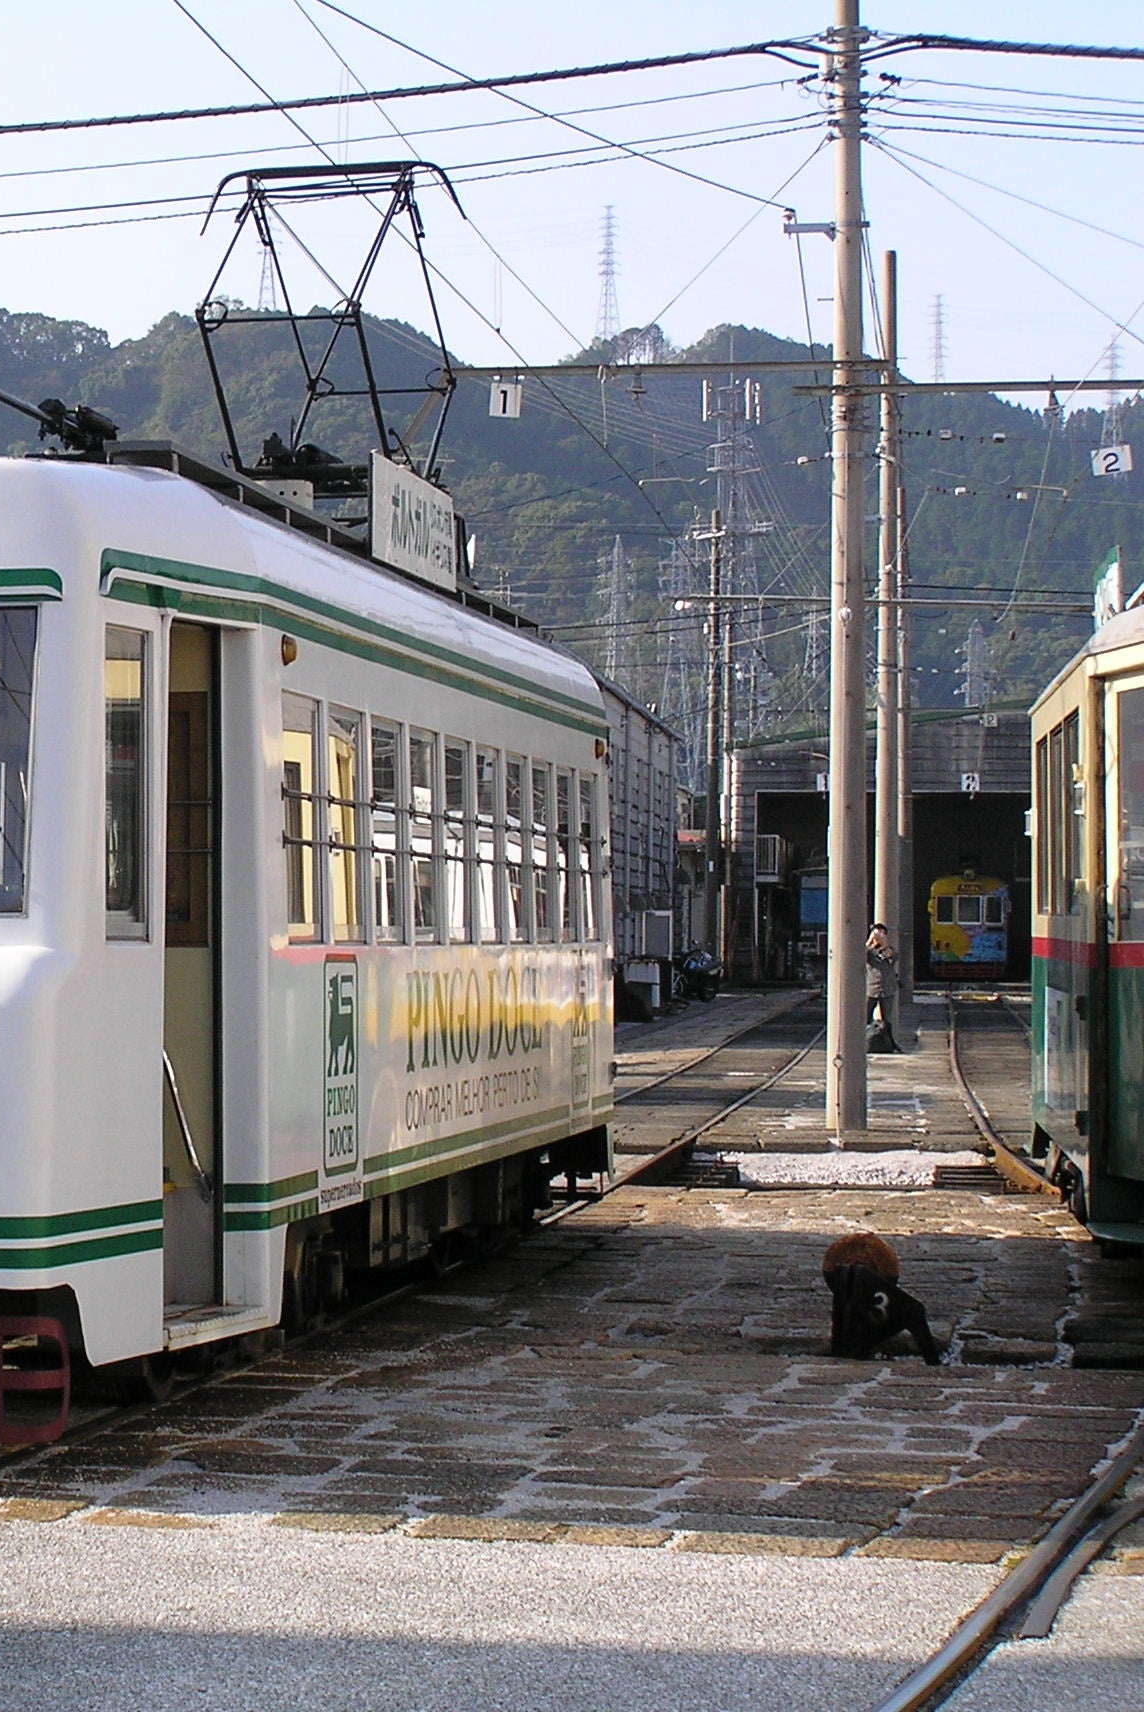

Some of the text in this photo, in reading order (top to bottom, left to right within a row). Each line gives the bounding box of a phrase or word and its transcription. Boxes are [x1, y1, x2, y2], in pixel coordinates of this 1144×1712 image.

[499, 389, 508, 415] 1
[1102, 452, 1121, 474] 2
[406, 966, 543, 1073] PINGO DOCE
[327, 1083, 355, 1117] PINGO
[406, 1083, 454, 1131] COMPRAR
[329, 1125, 354, 1157] DOCE
